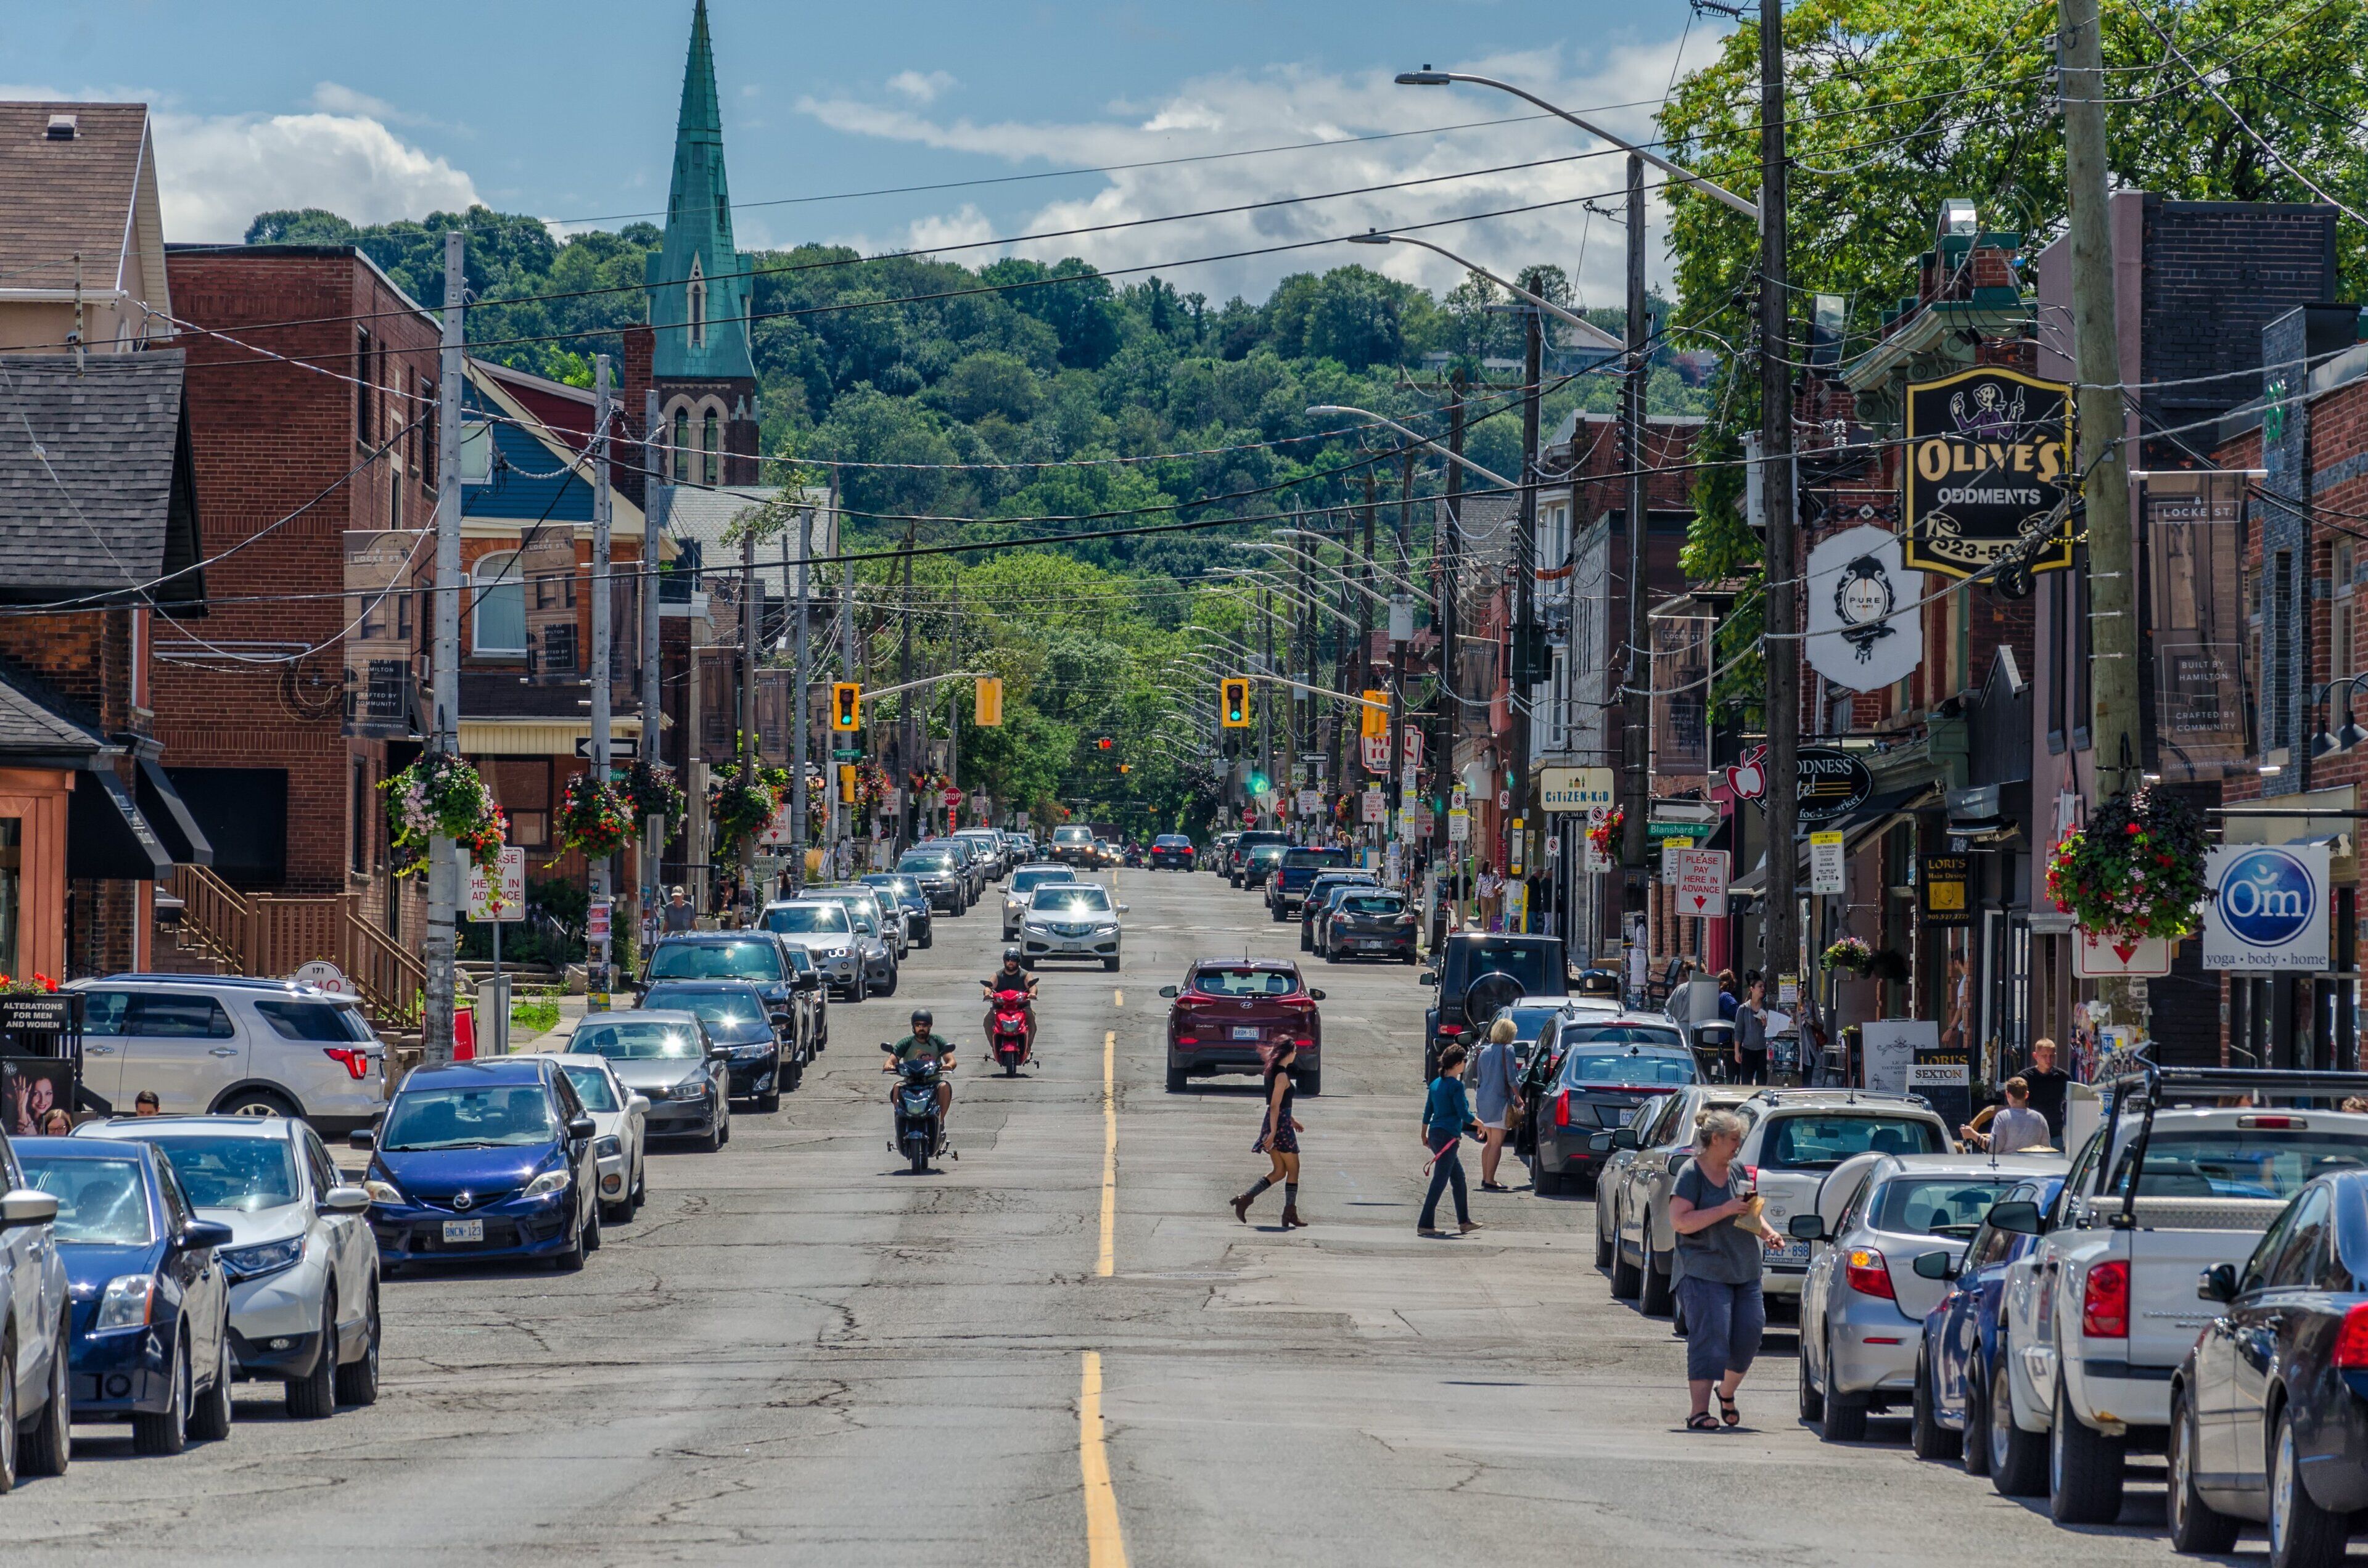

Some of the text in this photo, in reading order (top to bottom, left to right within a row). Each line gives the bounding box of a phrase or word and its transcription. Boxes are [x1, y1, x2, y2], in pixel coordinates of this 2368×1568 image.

[1938, 488, 2041, 504] ODDMENTS
[2163, 507, 2233, 517] LOCKE ST.
[2182, 661, 2208, 669] BUILT
[2179, 673, 2229, 681] HAMILTON
[2177, 723, 2236, 732] COMMUNITY
[2169, 759, 2251, 770] LOCKESTREETSHOPS.COM
[1651, 825, 1693, 834] Blanshard
[496, 855, 517, 864] ASE
[1686, 856, 1718, 864] PLEASE
[1928, 859, 1966, 869] LORI'S
[508, 879, 520, 888] IN
[1684, 875, 1706, 883] HERE
[1682, 884, 1720, 893] ADVANCE
[472, 891, 520, 901] ADNCE
[2227, 880, 2305, 917] Om
[2206, 953, 2326, 967] yoga body home
[3, 1002, 63, 1010] ALTERATIONS
[1915, 1069, 1963, 1079] SEXTON
[1792, 1246, 1809, 1257] 898
